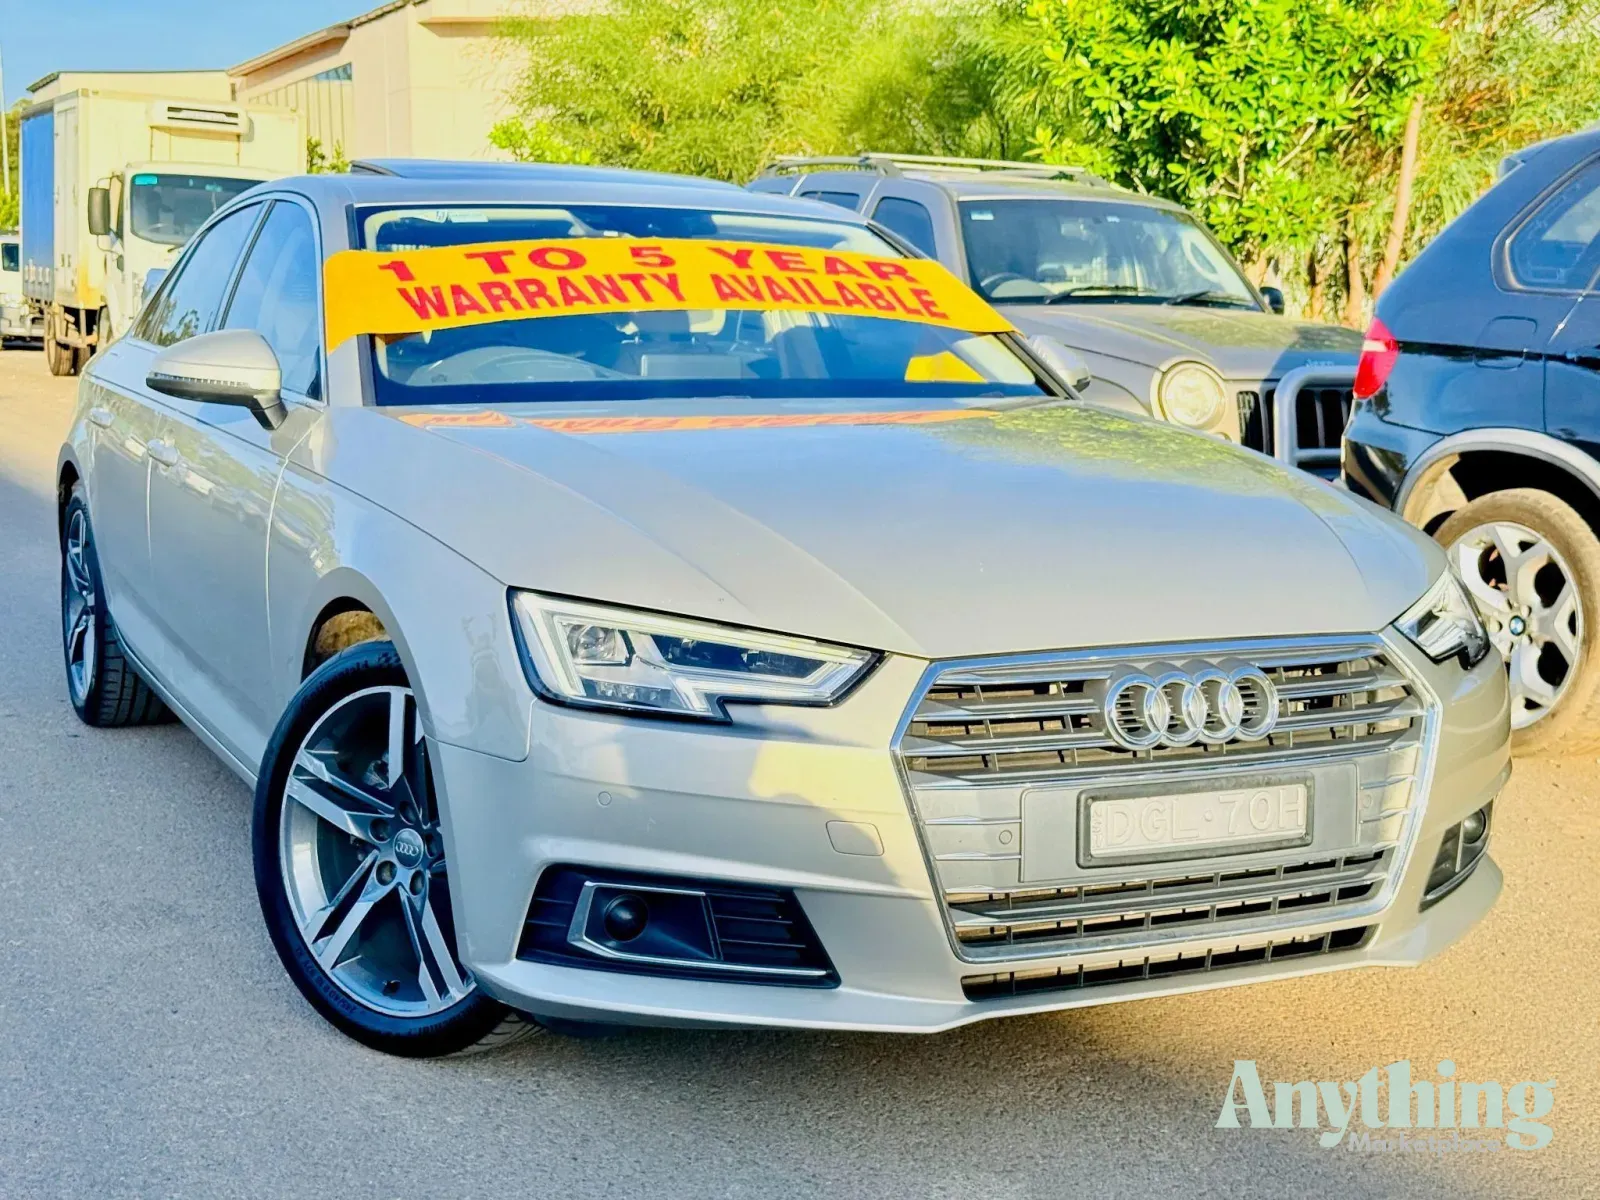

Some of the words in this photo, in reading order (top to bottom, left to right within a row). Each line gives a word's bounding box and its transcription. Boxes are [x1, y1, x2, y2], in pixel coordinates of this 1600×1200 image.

[378, 260, 416, 282] 1
[464, 247, 587, 275] TO
[629, 246, 676, 268] 5
[706, 246, 921, 284] YEAR
[396, 273, 687, 321] WARRANTY
[710, 273, 951, 320] AVAILABLE
